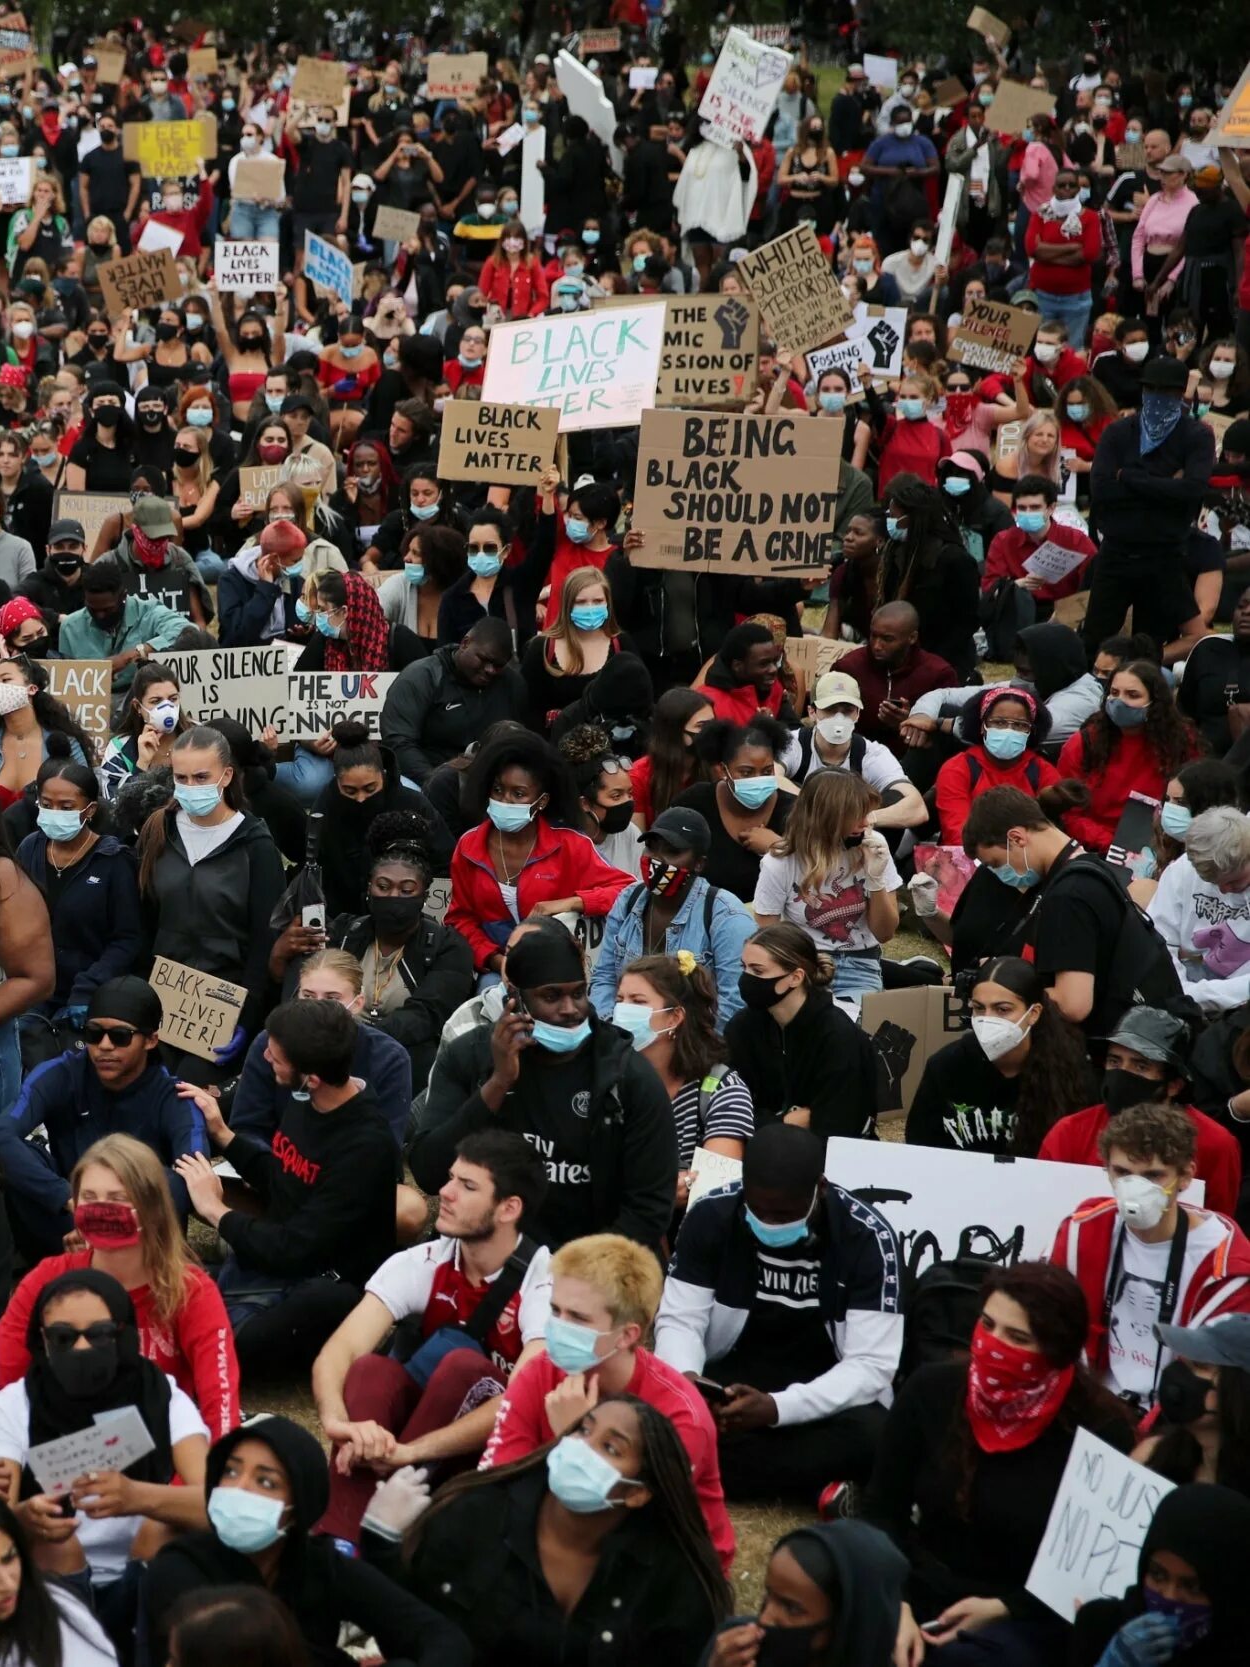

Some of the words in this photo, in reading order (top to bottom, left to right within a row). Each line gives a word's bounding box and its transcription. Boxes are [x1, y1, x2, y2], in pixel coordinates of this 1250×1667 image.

[140, 122, 202, 142] FEEL
[159, 143, 187, 158] THE
[223, 244, 270, 258] BLACK
[742, 224, 816, 276] WHITE
[107, 254, 167, 284] MATTER
[231, 258, 260, 270] LIVES
[116, 272, 167, 292] LIVES
[762, 266, 838, 317] TERRORISM
[122, 286, 166, 309] BLACK
[670, 307, 707, 325] THE
[969, 302, 1011, 326] YOUR
[510, 318, 649, 365] BLACK
[663, 331, 704, 349] MIC
[962, 319, 1011, 340] SILENCE
[537, 359, 617, 392] LIVES
[661, 353, 725, 370] SSION
[730, 353, 755, 372] OF
[478, 405, 542, 431] BLACK
[455, 428, 510, 449] LIVES
[683, 417, 796, 458] BEING
[464, 451, 543, 473] MATTER
[646, 458, 743, 493] BLACK
[662, 492, 774, 526] SHOULD
[779, 492, 838, 524] NOT
[684, 528, 722, 563] BE
[731, 529, 761, 562] A
[765, 530, 834, 567] CRIME
[210, 650, 285, 682] SILENCE
[44, 664, 107, 696] LACK
[288, 675, 332, 701] THE
[340, 673, 379, 700] UK
[202, 685, 220, 704] IS
[306, 701, 320, 710] IS
[325, 700, 348, 710] NOT
[155, 961, 205, 1000] BLACK
[178, 998, 225, 1028] LIVES
[1075, 1449, 1104, 1486] NO
[1048, 1498, 1091, 1573] NO
